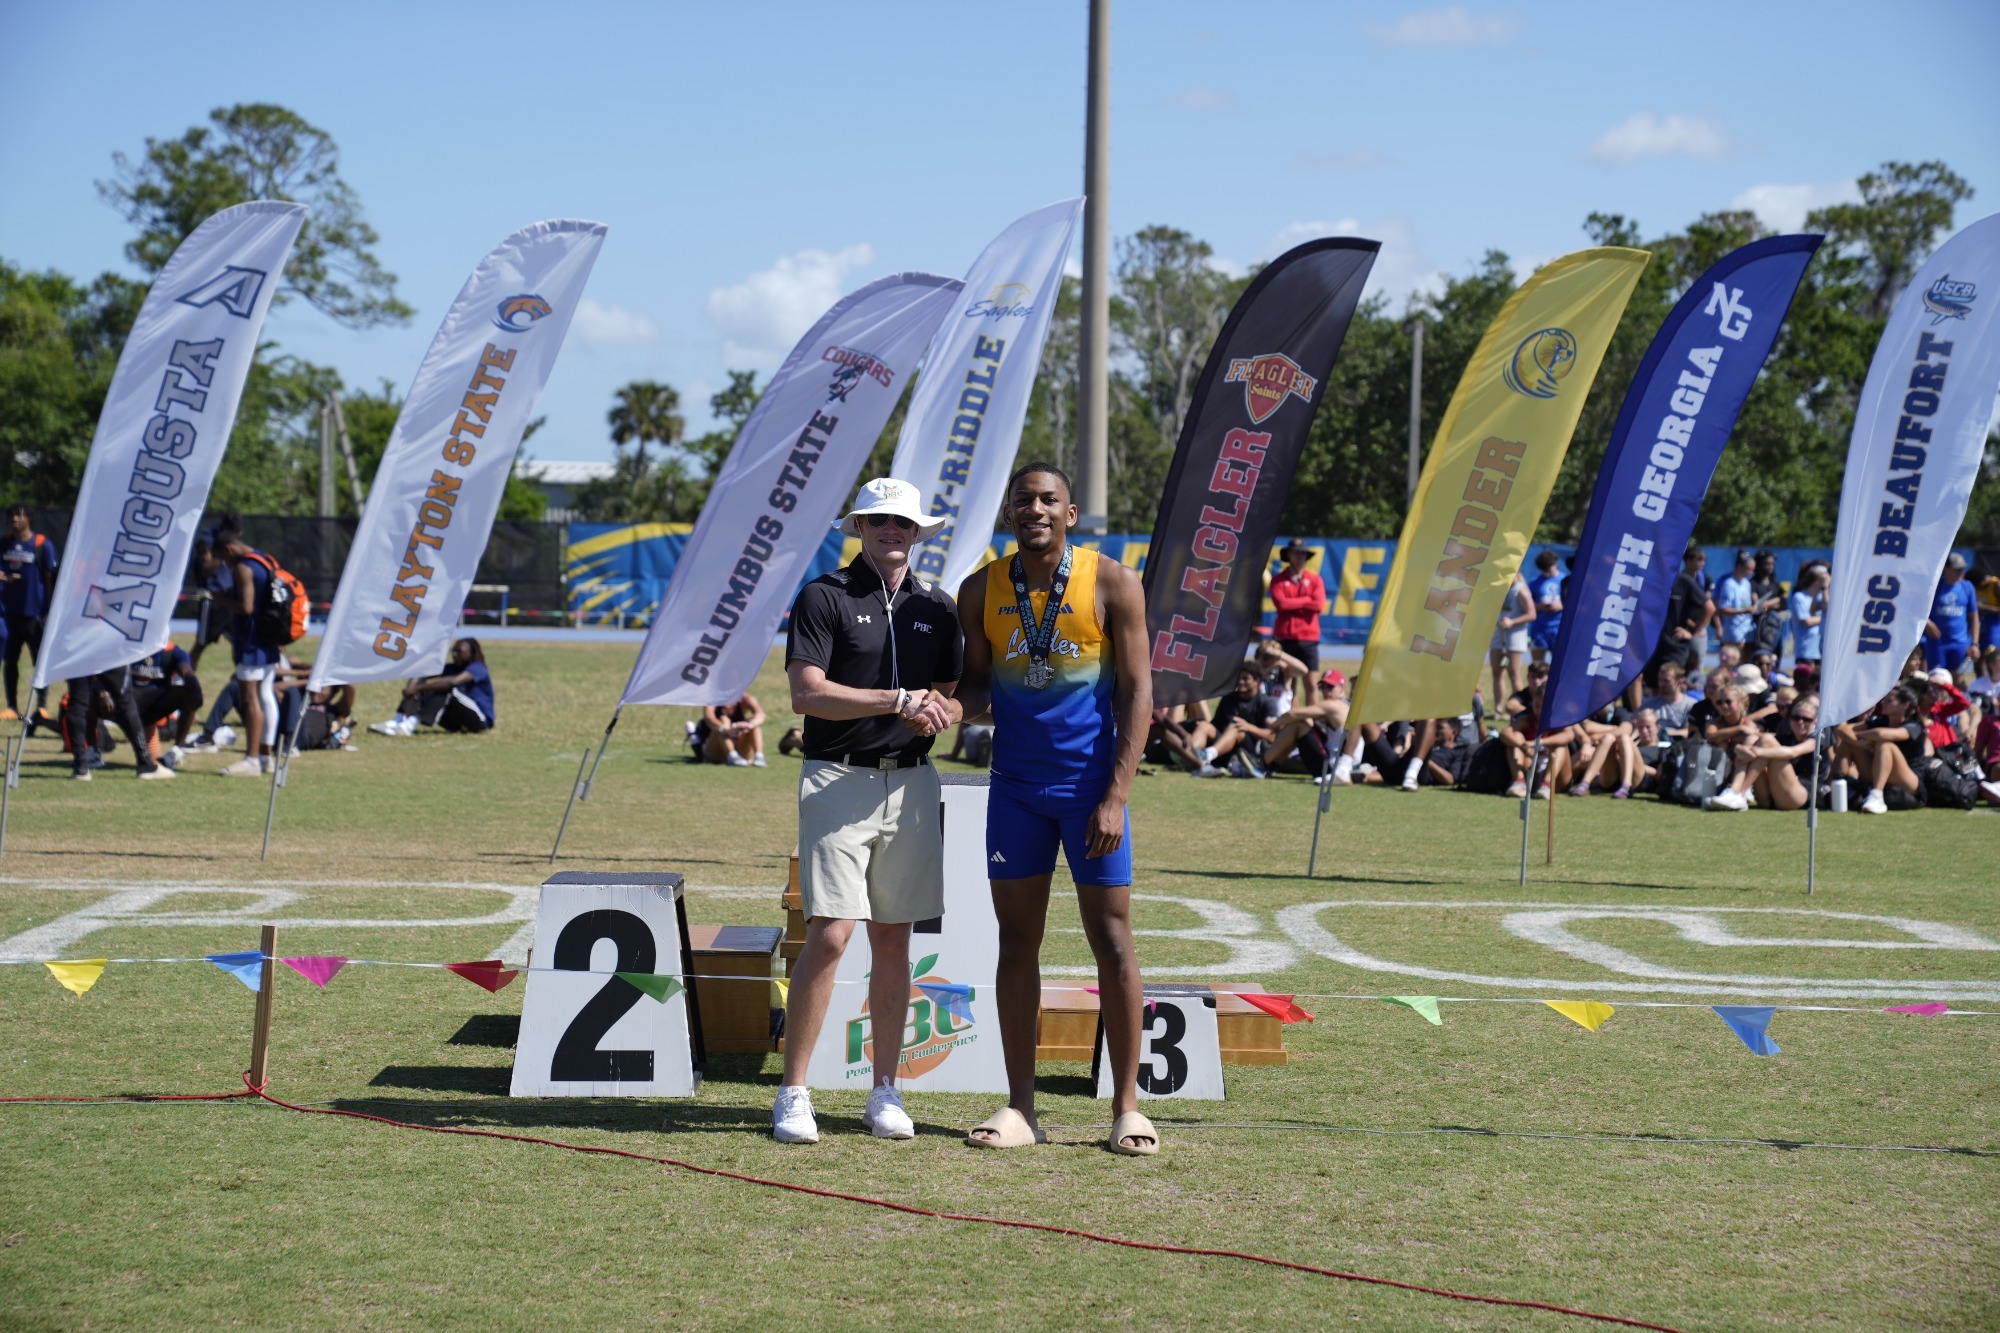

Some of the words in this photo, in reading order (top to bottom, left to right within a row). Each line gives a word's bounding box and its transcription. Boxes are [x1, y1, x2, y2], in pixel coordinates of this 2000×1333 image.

[965, 300, 1034, 322] Eagles
[1932, 280, 1975, 297] USCB
[821, 344, 896, 388] COUGARS
[1228, 361, 1314, 399] FLAGLER
[1251, 383, 1281, 401] Saints
[82, 337, 224, 642] AUGUSTA
[914, 335, 1006, 588] BRY-RIDDLE
[1874, 331, 1953, 559] BEAUFORT
[372, 469, 461, 660] CLAYTON
[442, 343, 517, 467] STATE
[681, 514, 785, 685] COLUMBUS
[768, 409, 839, 513] STATE
[1411, 435, 1527, 662] LANDER
[1587, 533, 1654, 681] NORTH
[1632, 345, 1723, 522] GEORGIA
[1151, 427, 1272, 680] FLAGLER
[914, 621, 933, 634] PBC
[1005, 627, 1080, 662] Lader
[1857, 574, 1901, 655] USC
[550, 908, 656, 1082] 2
[911, 1034, 978, 1060] Conference
[1136, 1001, 1188, 1095] 3
